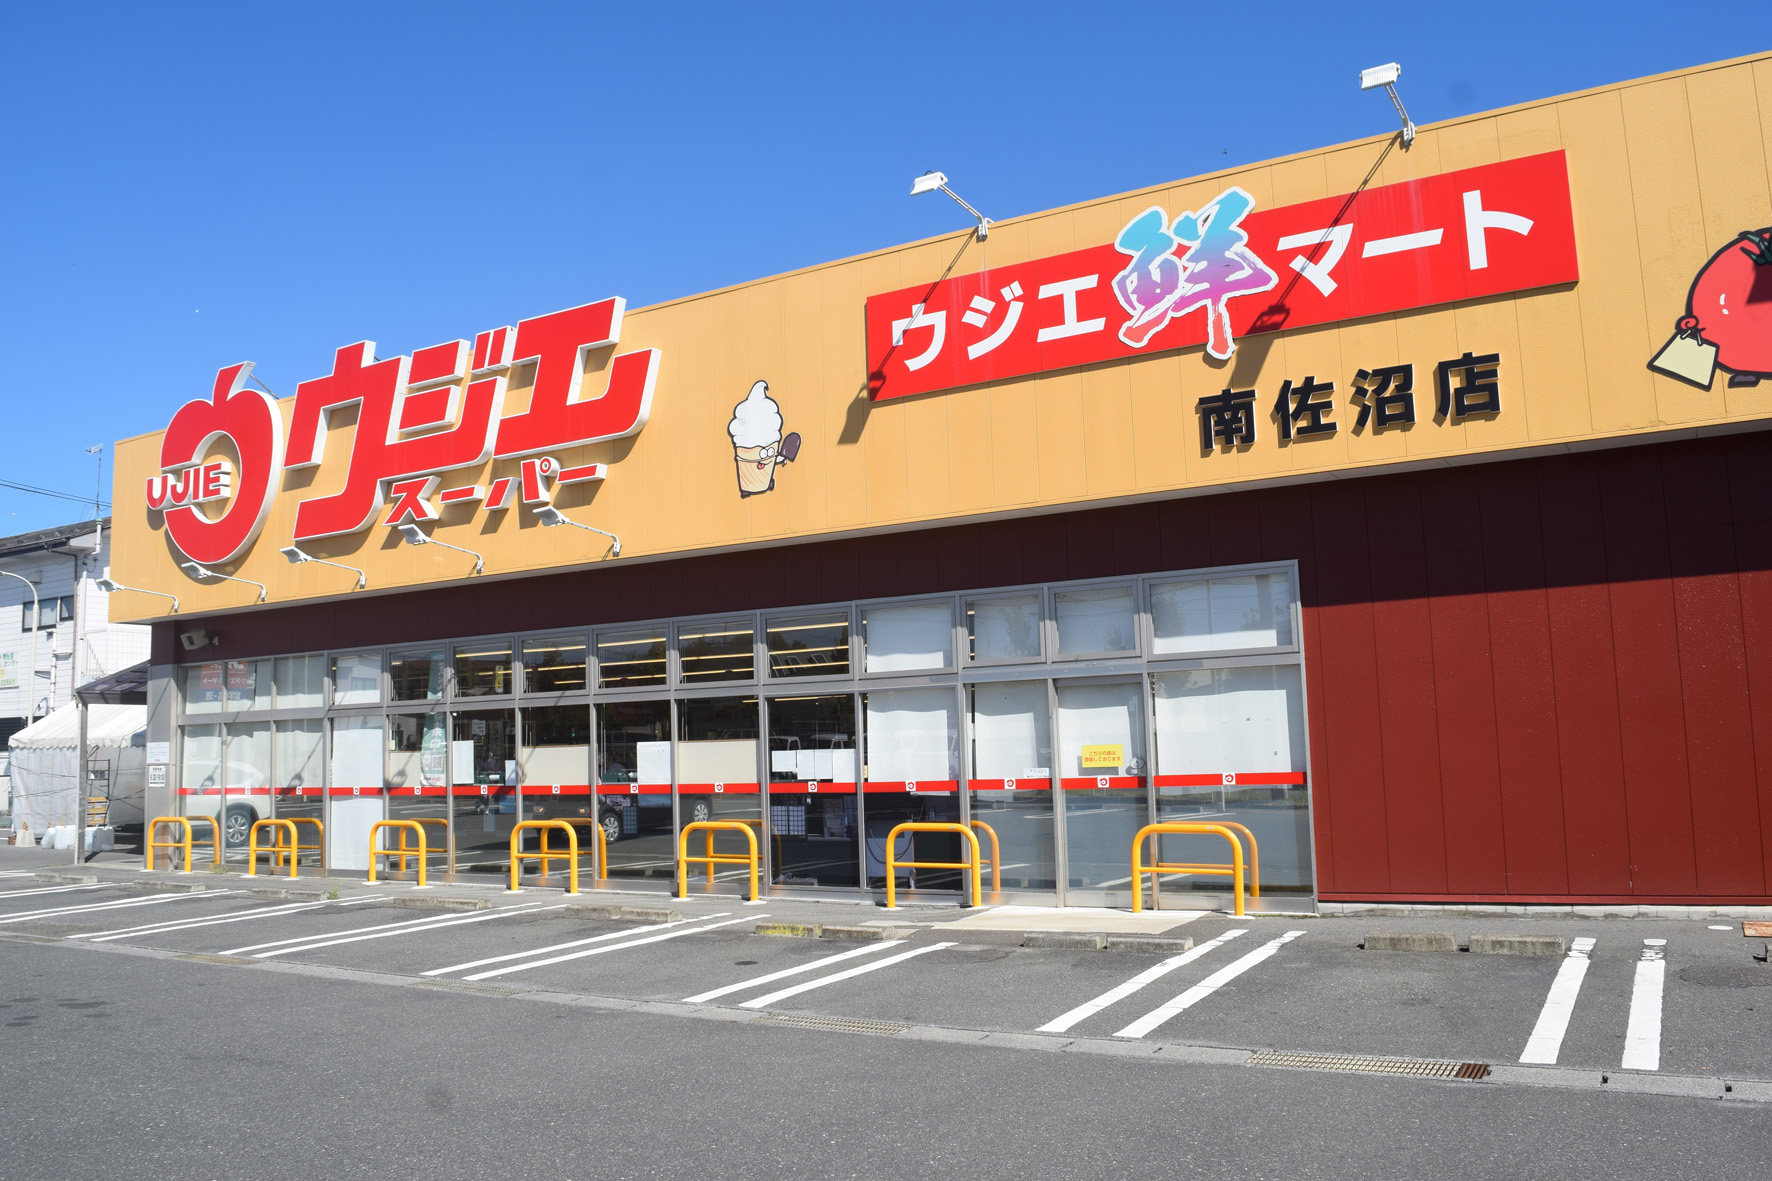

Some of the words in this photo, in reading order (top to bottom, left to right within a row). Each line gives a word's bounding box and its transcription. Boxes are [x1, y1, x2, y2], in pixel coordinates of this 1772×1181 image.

[284, 296, 661, 540] ウジエ
[1198, 352, 1501, 450] 南佐沼店
[146, 461, 232, 511] UJIE
[382, 456, 608, 526] スーパー
